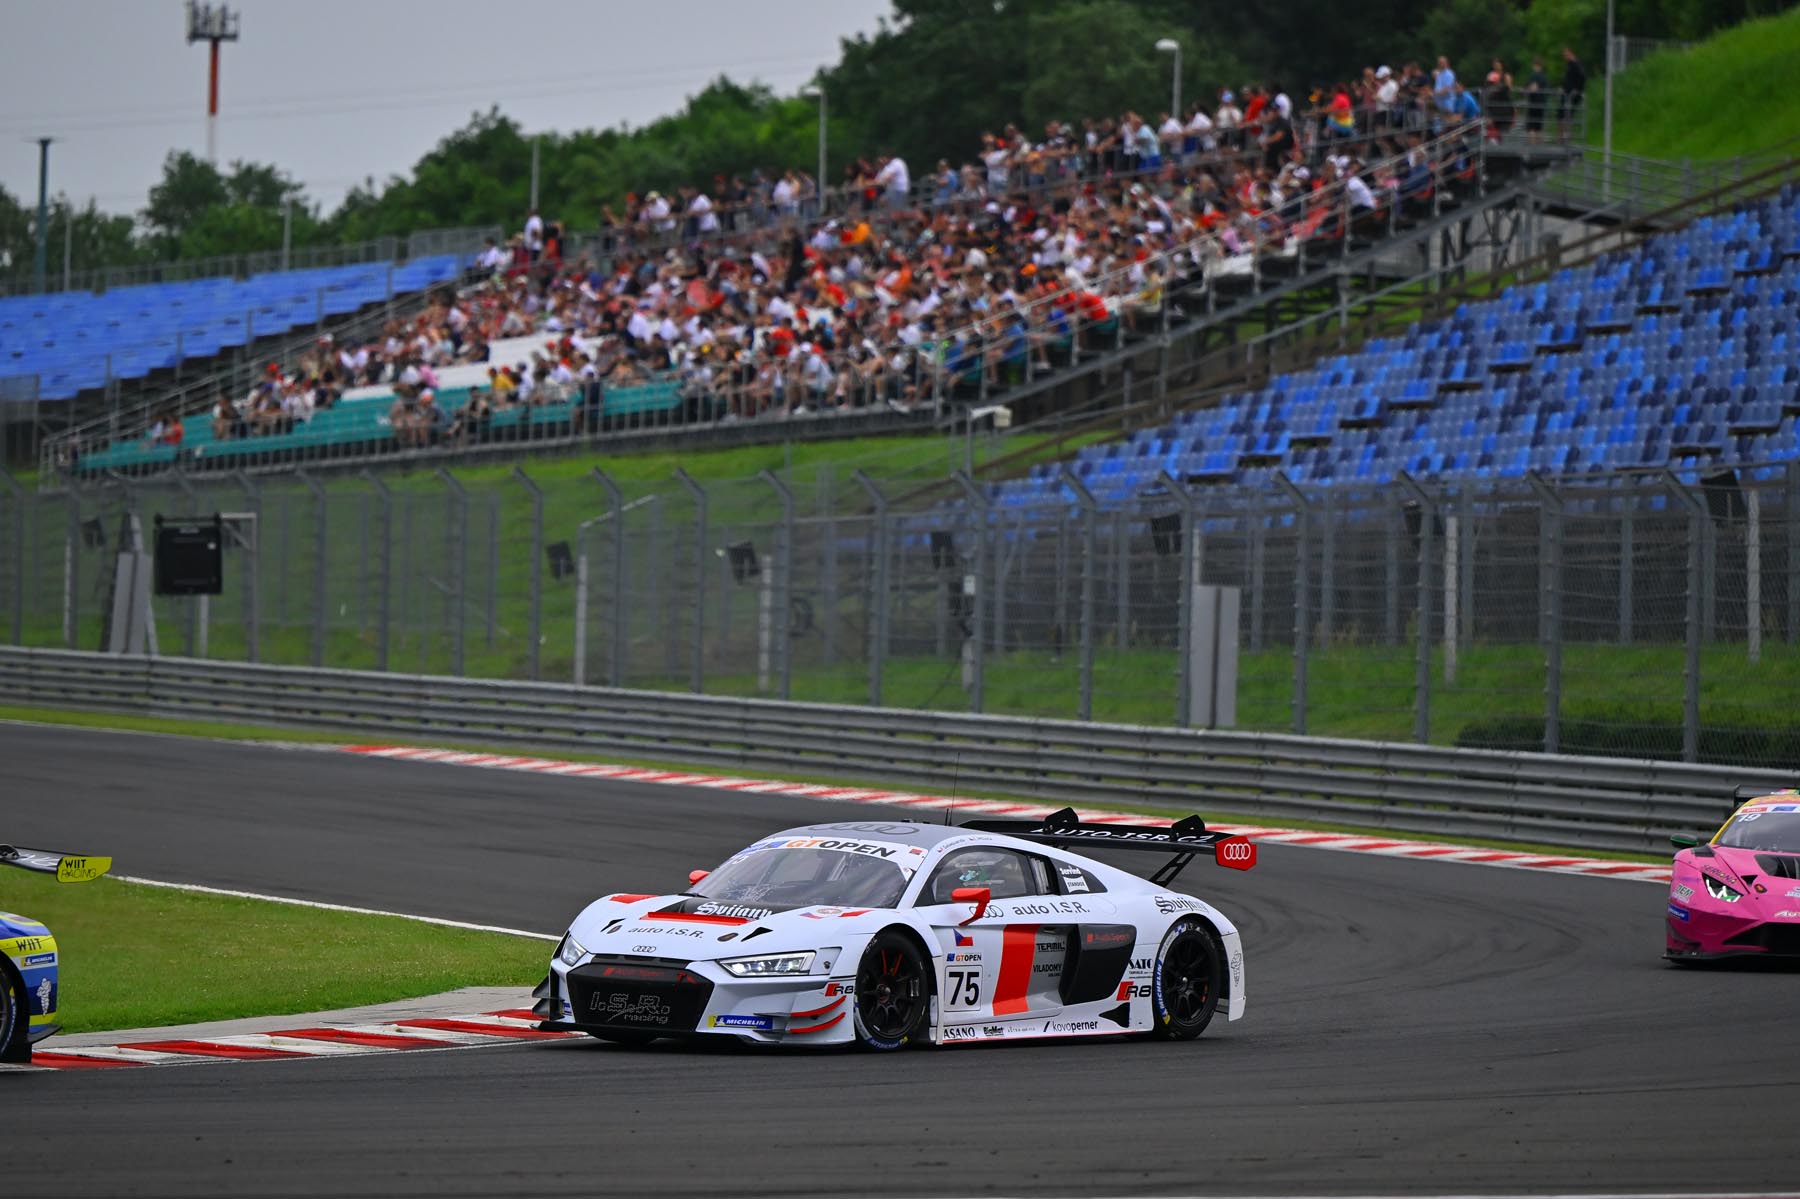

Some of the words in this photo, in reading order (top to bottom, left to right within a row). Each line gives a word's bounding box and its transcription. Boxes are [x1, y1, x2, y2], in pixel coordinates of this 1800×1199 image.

[1738, 813, 1761, 822] 19
[65, 859, 87, 869] WIIT
[1012, 903, 1050, 916] auto
[1050, 901, 1091, 914] I.S.R.
[627, 925, 664, 935] auto
[16, 938, 42, 952] WIIT
[956, 953, 982, 962] GTOPEN
[832, 984, 854, 995] R8
[949, 971, 980, 1006] 75
[1125, 984, 1152, 998] R8
[725, 1018, 766, 1027] MICHELIN
[1052, 1020, 1099, 1033] kovoperner
